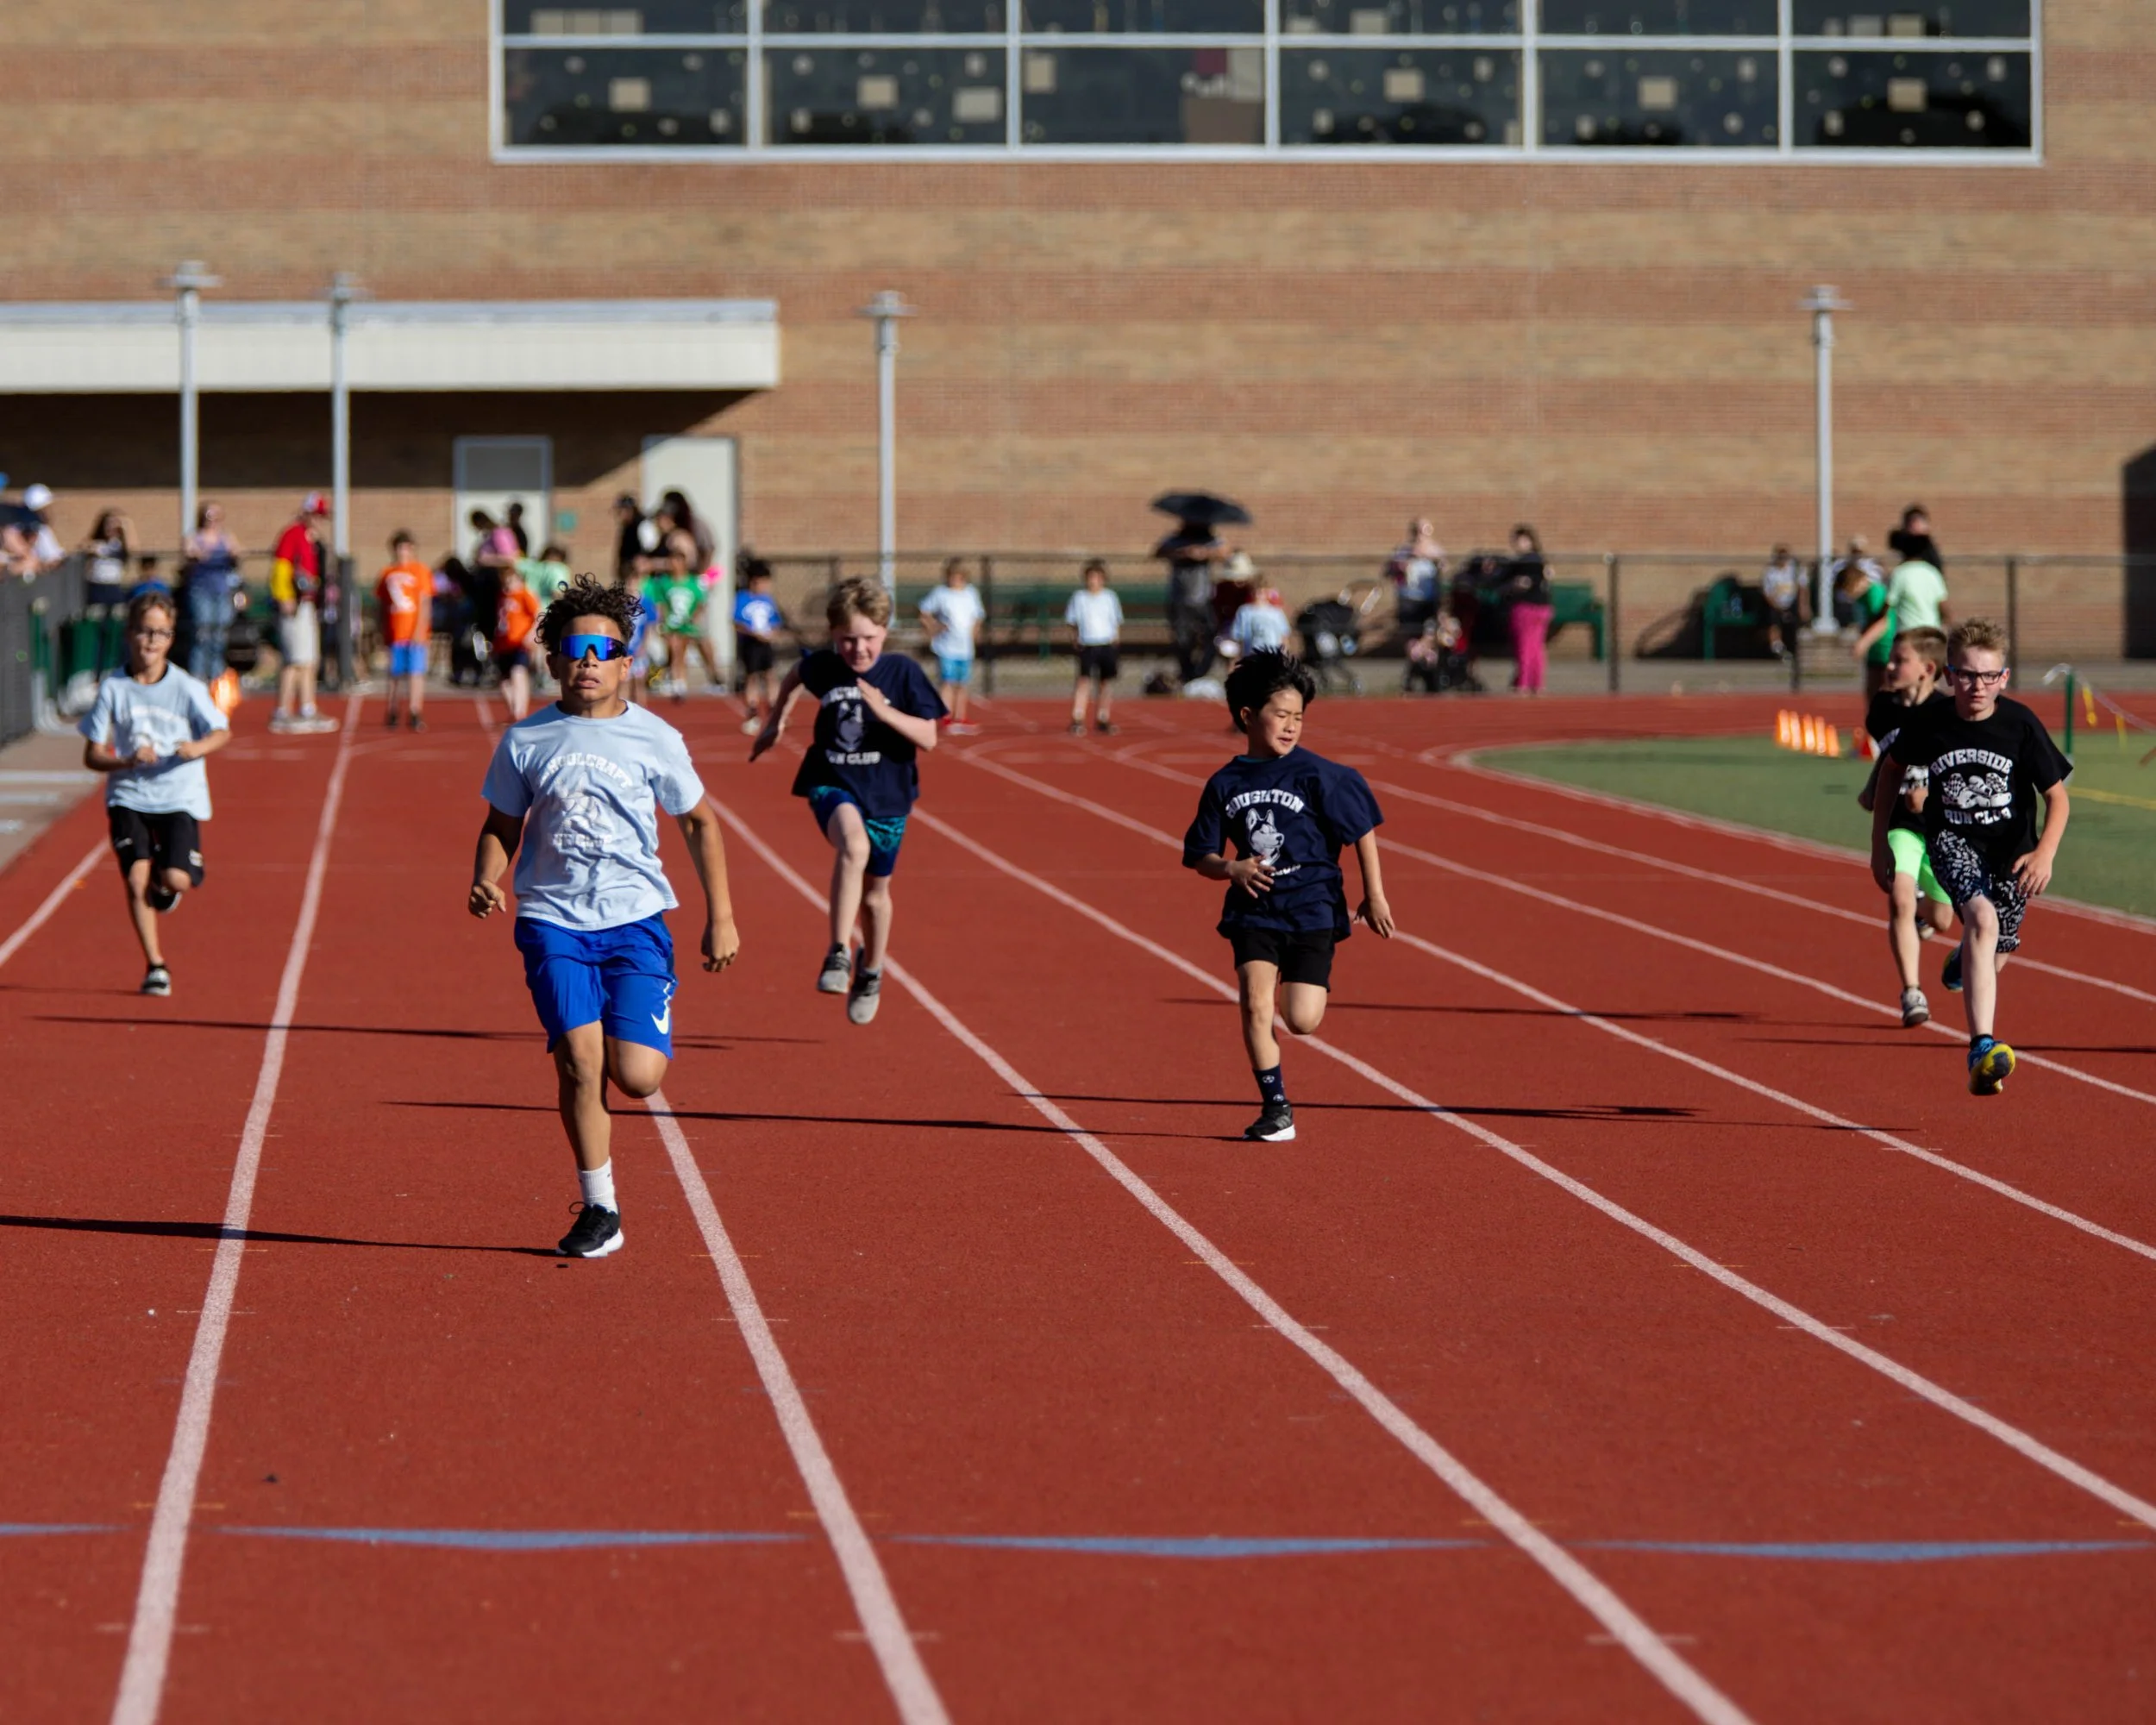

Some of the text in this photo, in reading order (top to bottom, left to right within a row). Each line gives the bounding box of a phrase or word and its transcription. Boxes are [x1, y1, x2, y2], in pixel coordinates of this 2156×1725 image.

[846, 751, 881, 765] CLUB
[1930, 749, 2013, 775] RIVERSIDE
[1944, 806, 2012, 825] RUN CLUB
